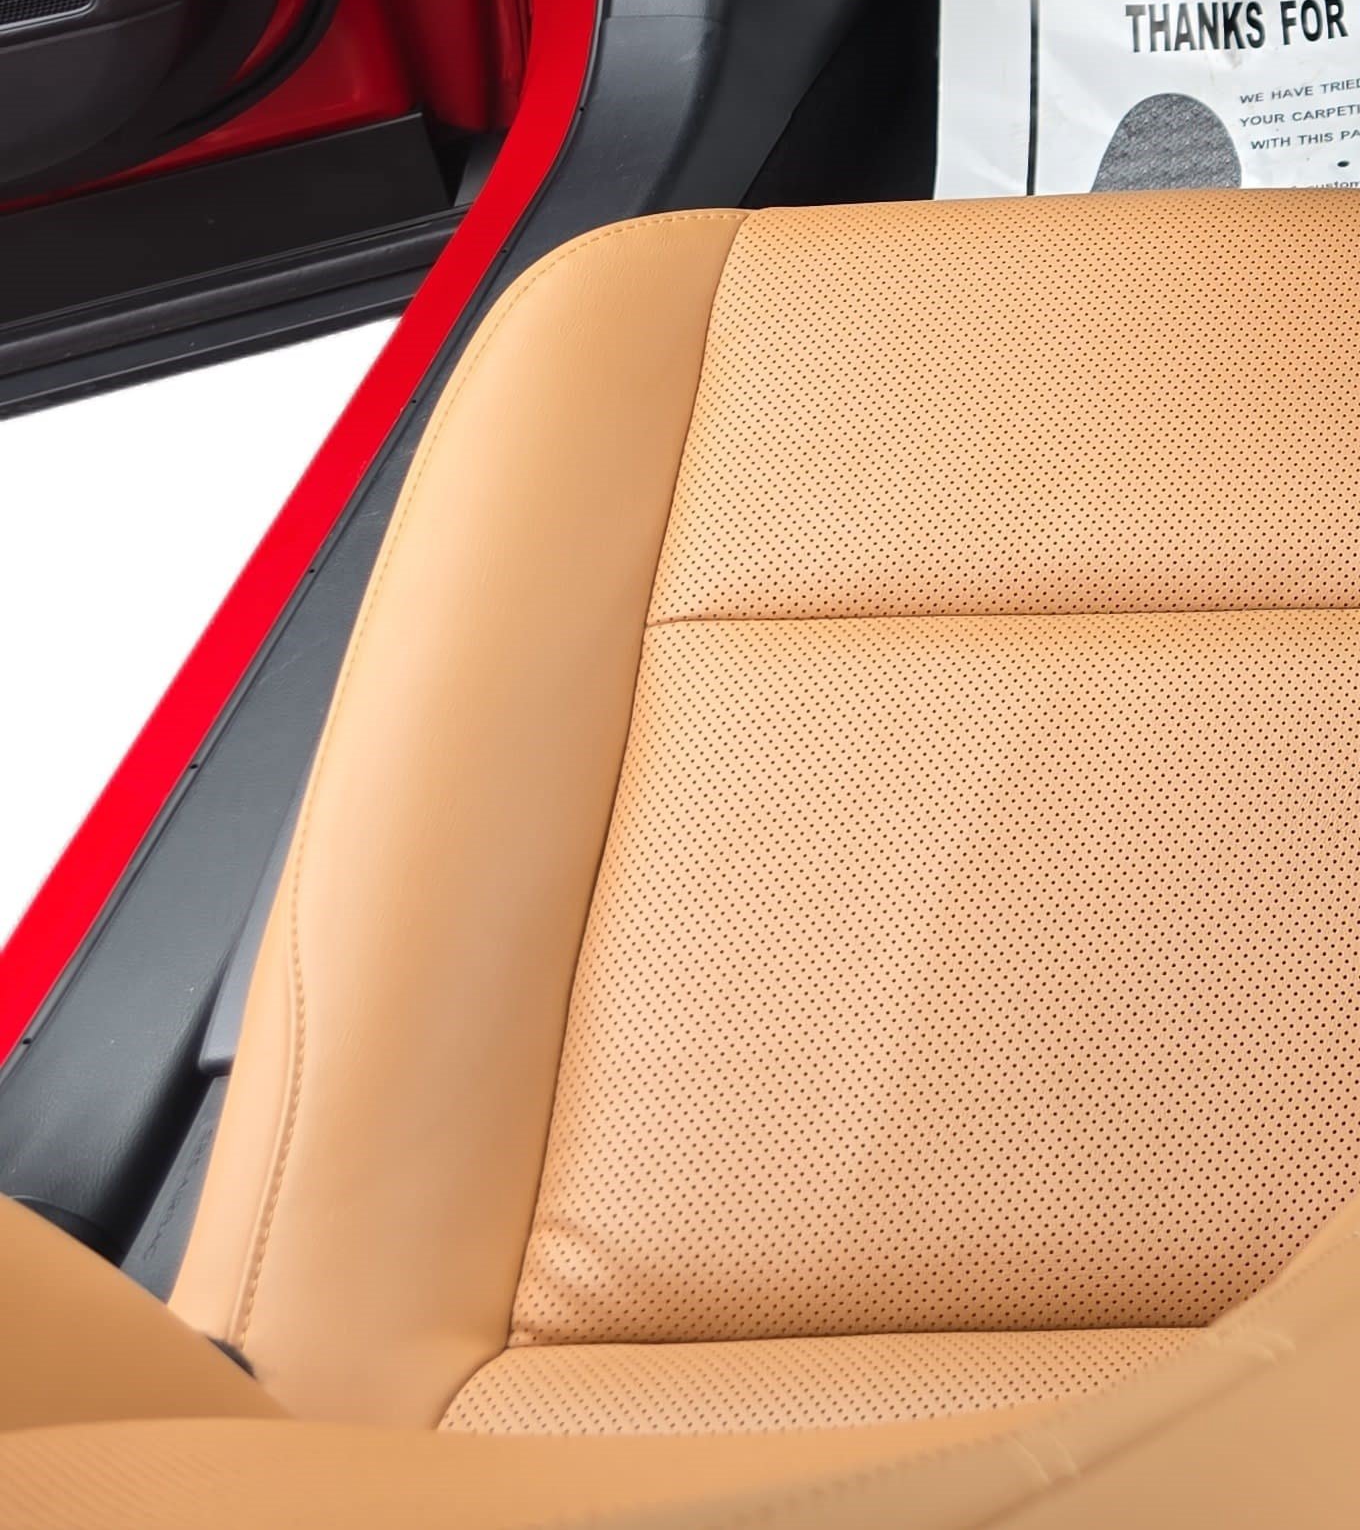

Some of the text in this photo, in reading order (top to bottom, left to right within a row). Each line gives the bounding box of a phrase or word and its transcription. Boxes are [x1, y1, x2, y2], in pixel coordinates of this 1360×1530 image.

[1125, 1, 1266, 54] THANKS
[1239, 92, 1265, 105] WE
[1271, 85, 1314, 100] HAVE
[1240, 113, 1285, 127] YOUR
[1250, 136, 1291, 150] WITH
[1298, 130, 1334, 146] THIS
